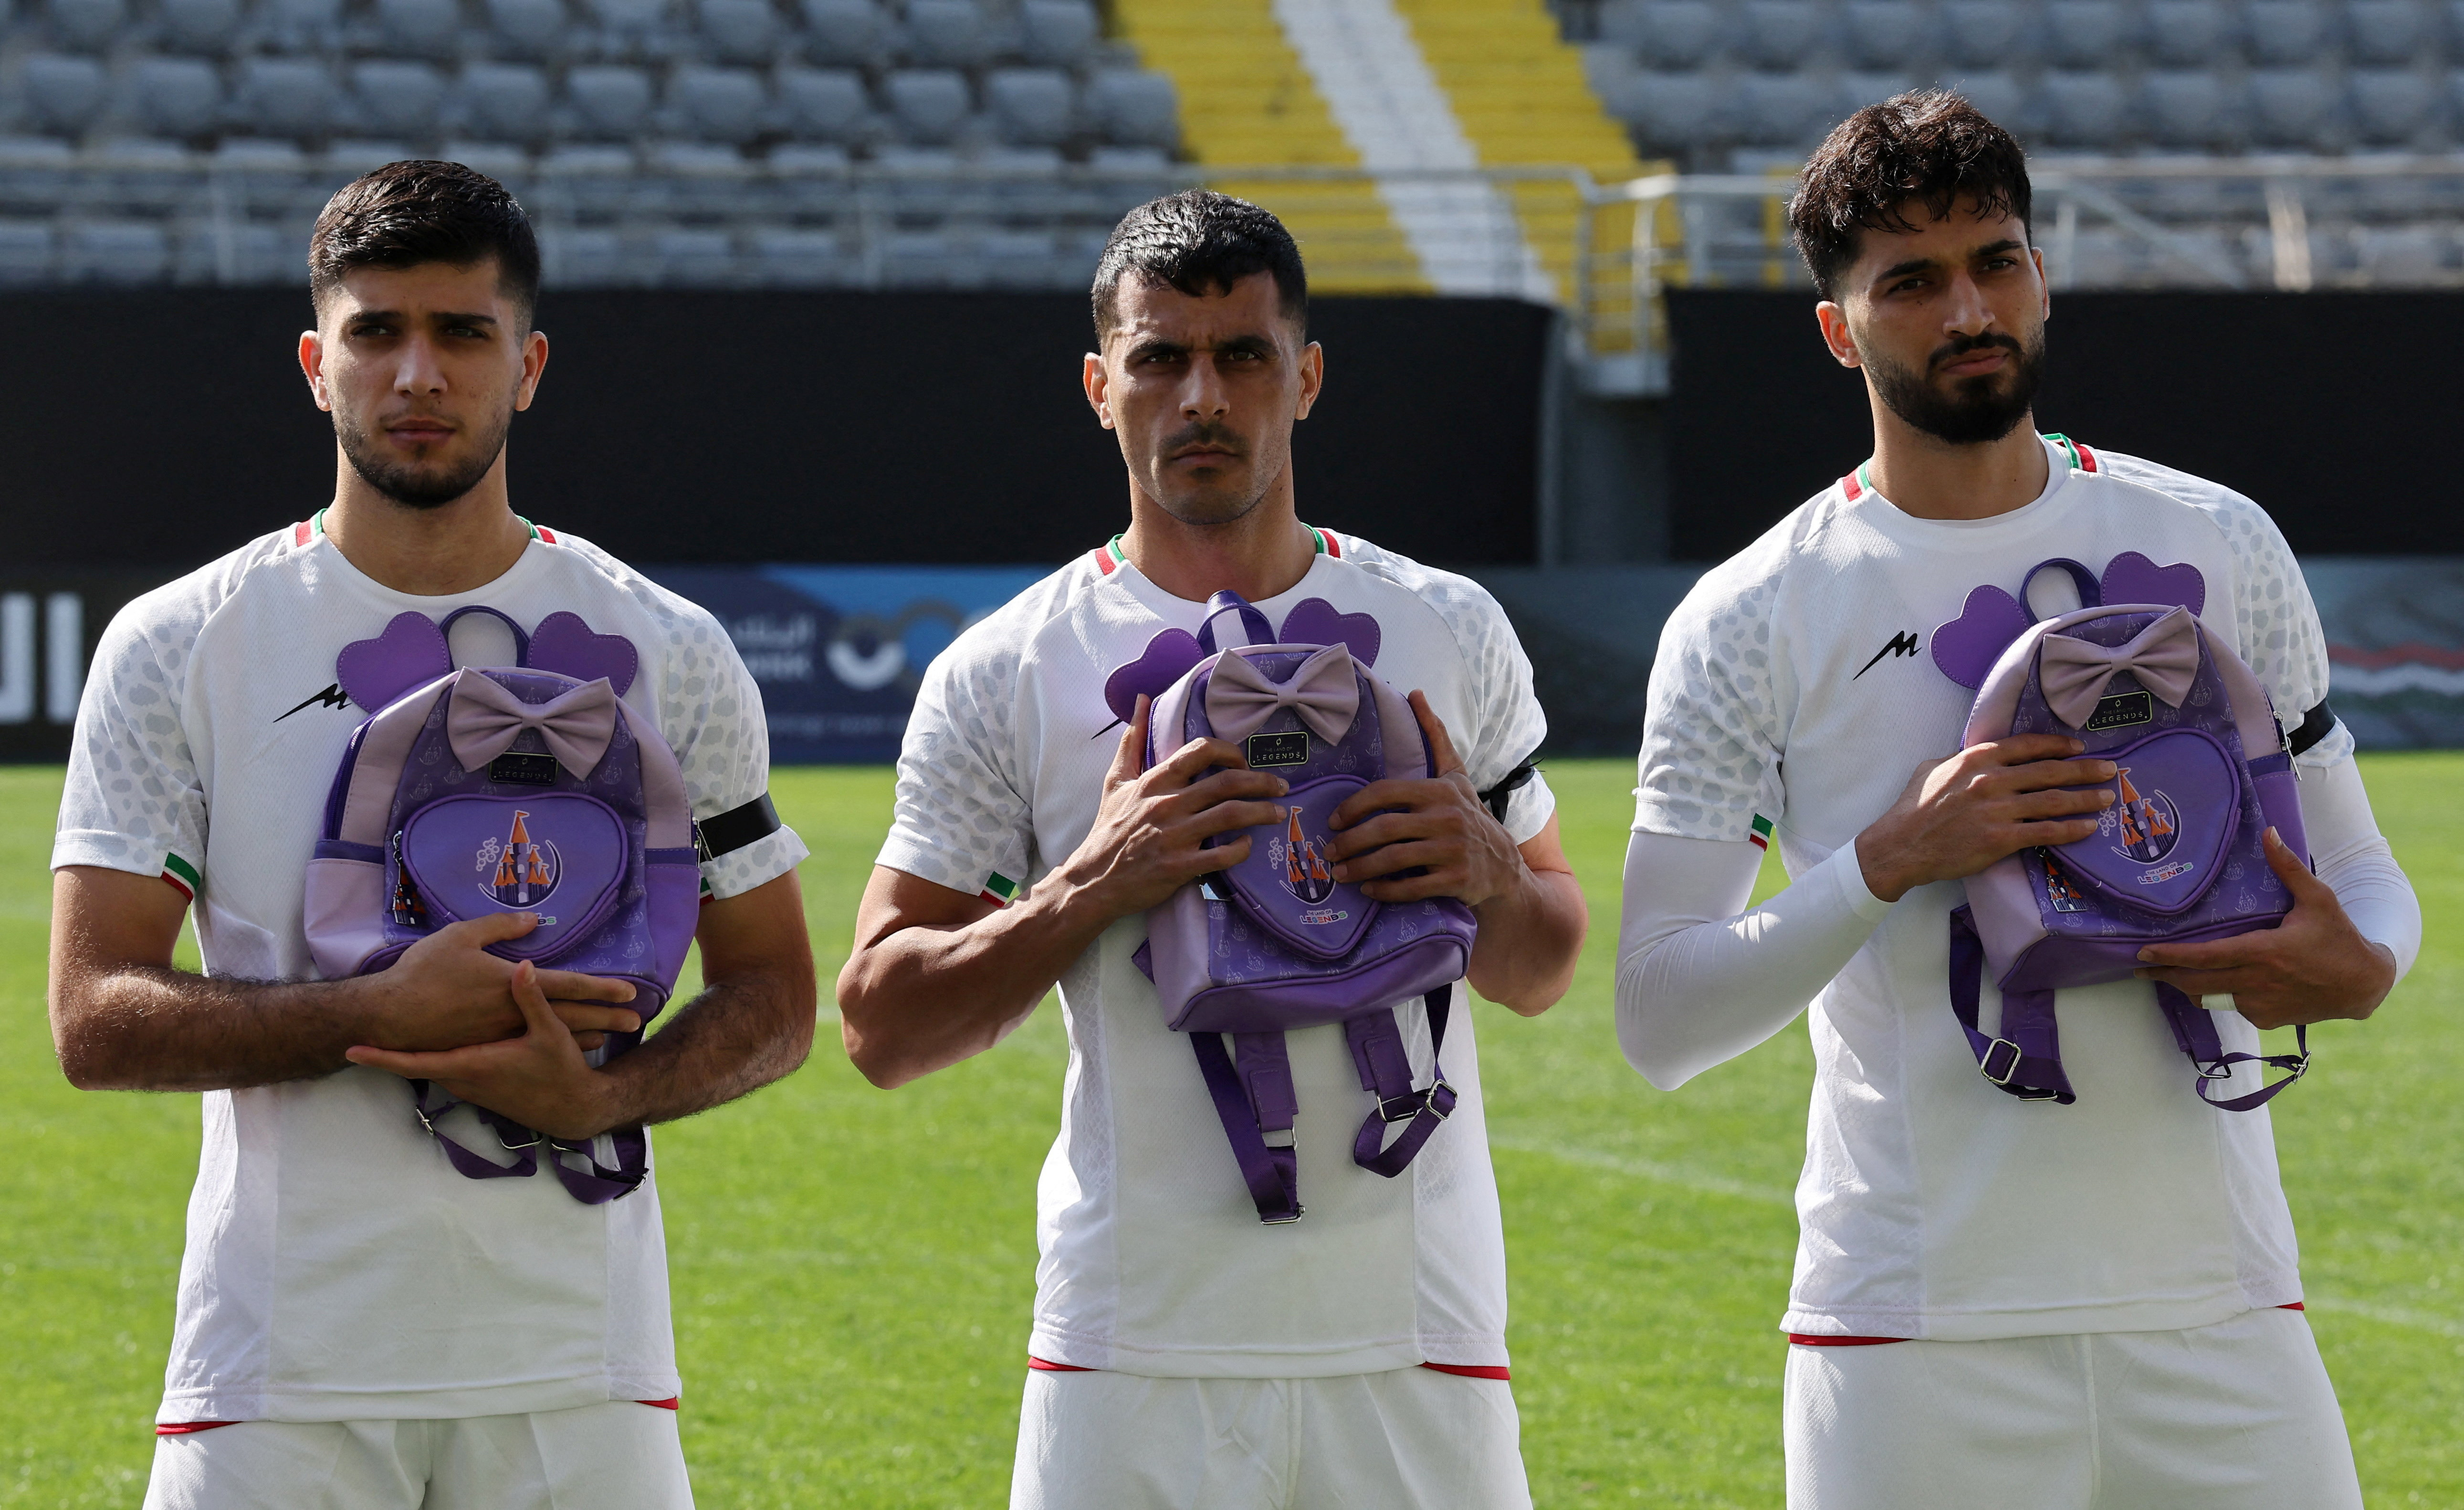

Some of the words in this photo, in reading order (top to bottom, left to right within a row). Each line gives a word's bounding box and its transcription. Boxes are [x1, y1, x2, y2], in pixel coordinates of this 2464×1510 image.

[2095, 711, 2142, 724] LEGENDS
[1257, 752, 1300, 761] LEGENDS
[499, 771, 547, 779] LEGENDS
[2139, 863, 2192, 883] LEGENDS
[1300, 912, 1346, 923] LEGENDS
